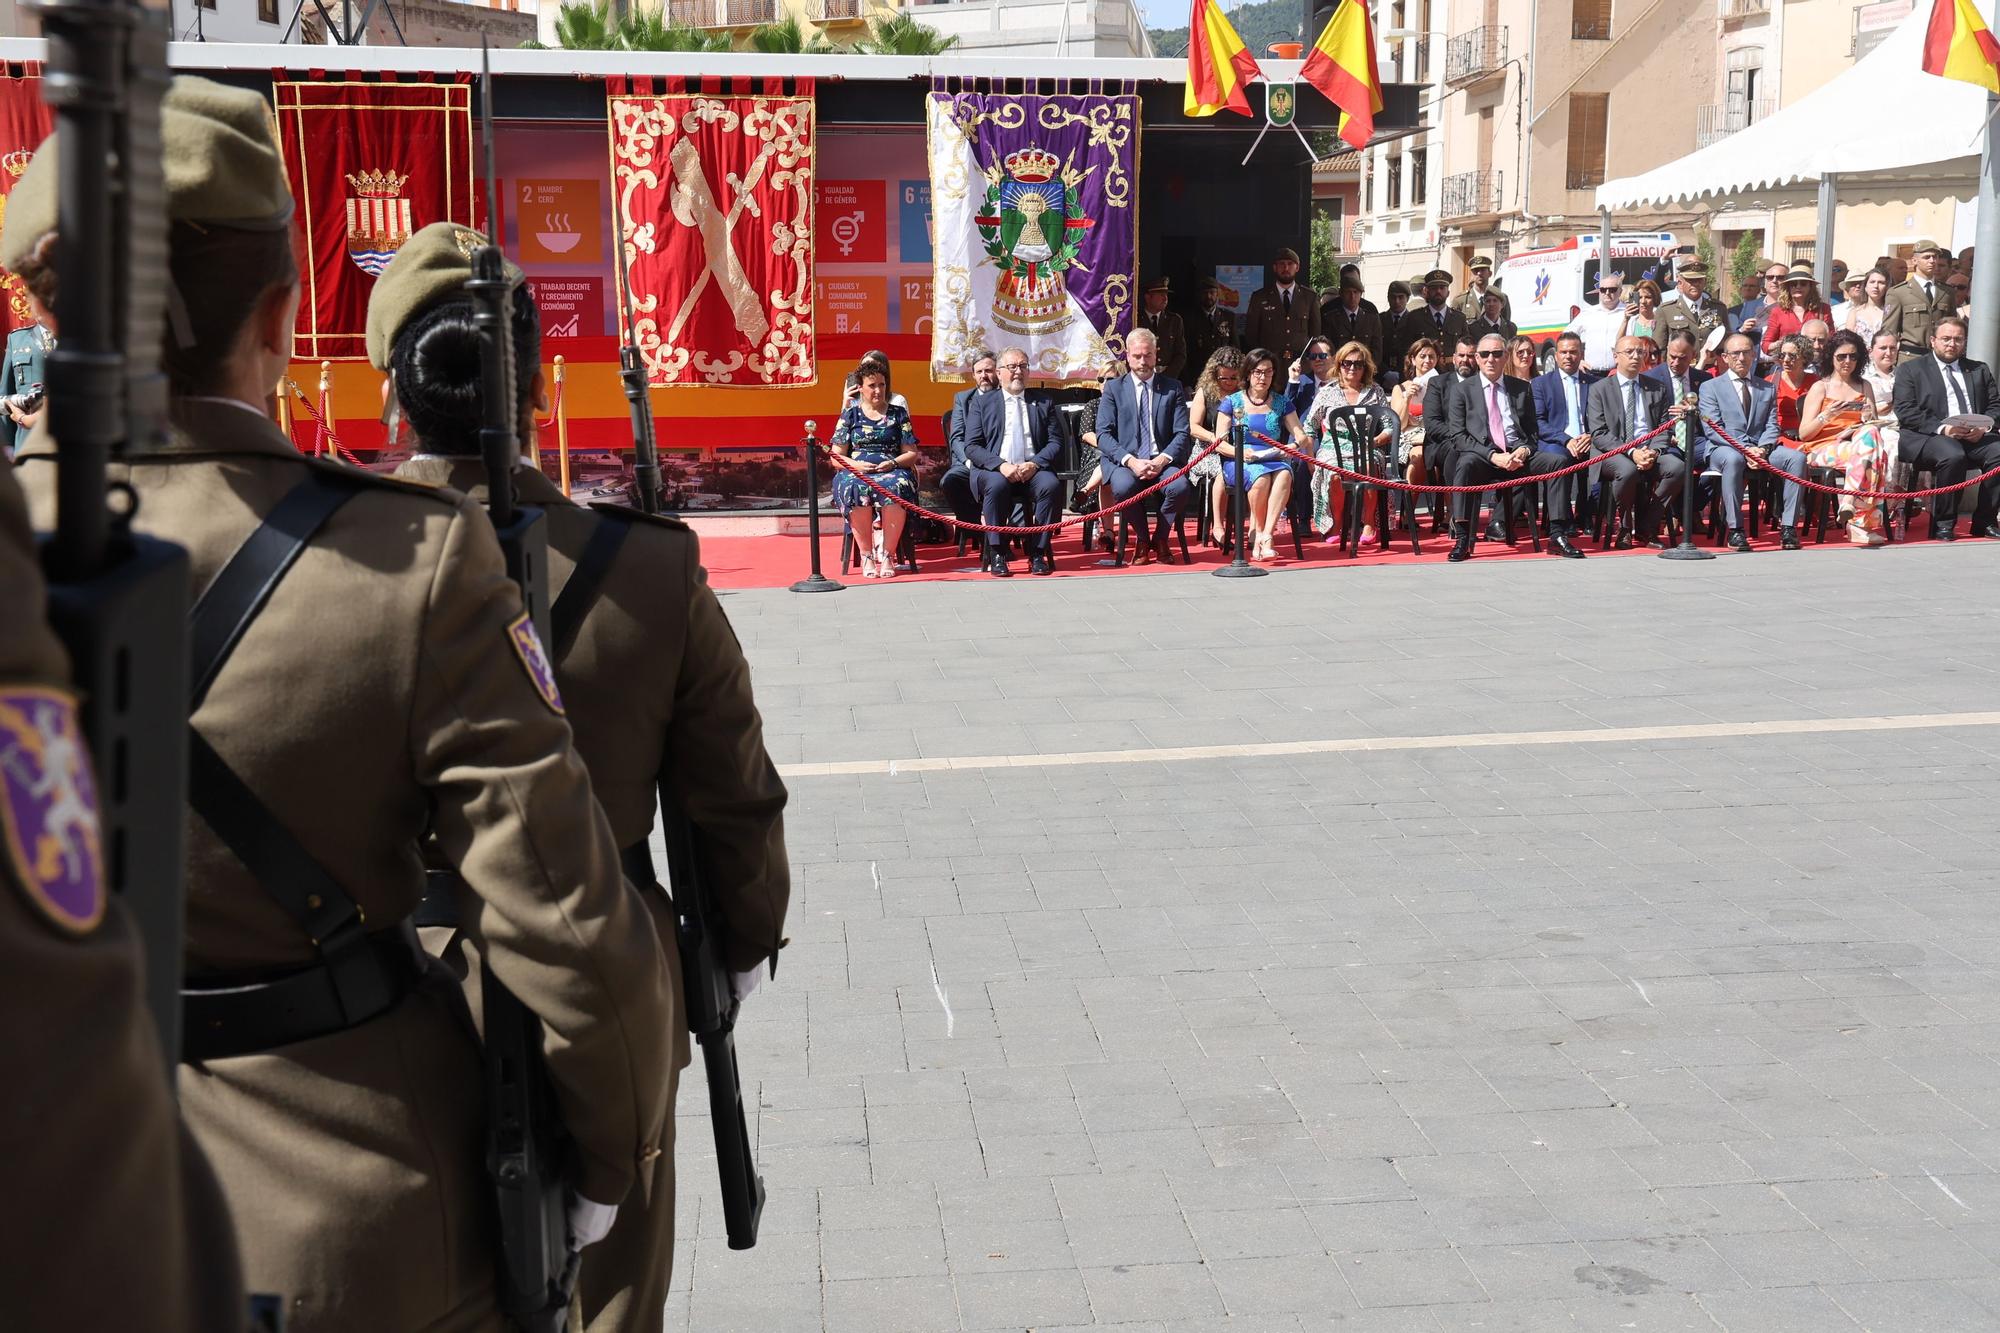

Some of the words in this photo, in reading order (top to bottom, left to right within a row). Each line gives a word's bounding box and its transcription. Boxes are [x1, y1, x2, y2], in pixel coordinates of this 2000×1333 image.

[537, 185, 563, 193] HAMBRE
[825, 186, 854, 194] IGUALDAD
[522, 185, 532, 203] 2
[905, 186, 915, 204] 6
[538, 195, 554, 203] CERO
[834, 195, 857, 204] GÉNERO
[540, 283, 566, 291] TRABAJO
[566, 283, 591, 291] DECENTE
[828, 282, 855, 290] CIUDADES
[855, 282, 860, 290] Y
[904, 282, 920, 300] 12
[541, 301, 575, 311] ECONÓMICO
[828, 302, 863, 310] SOSTENIBLES
